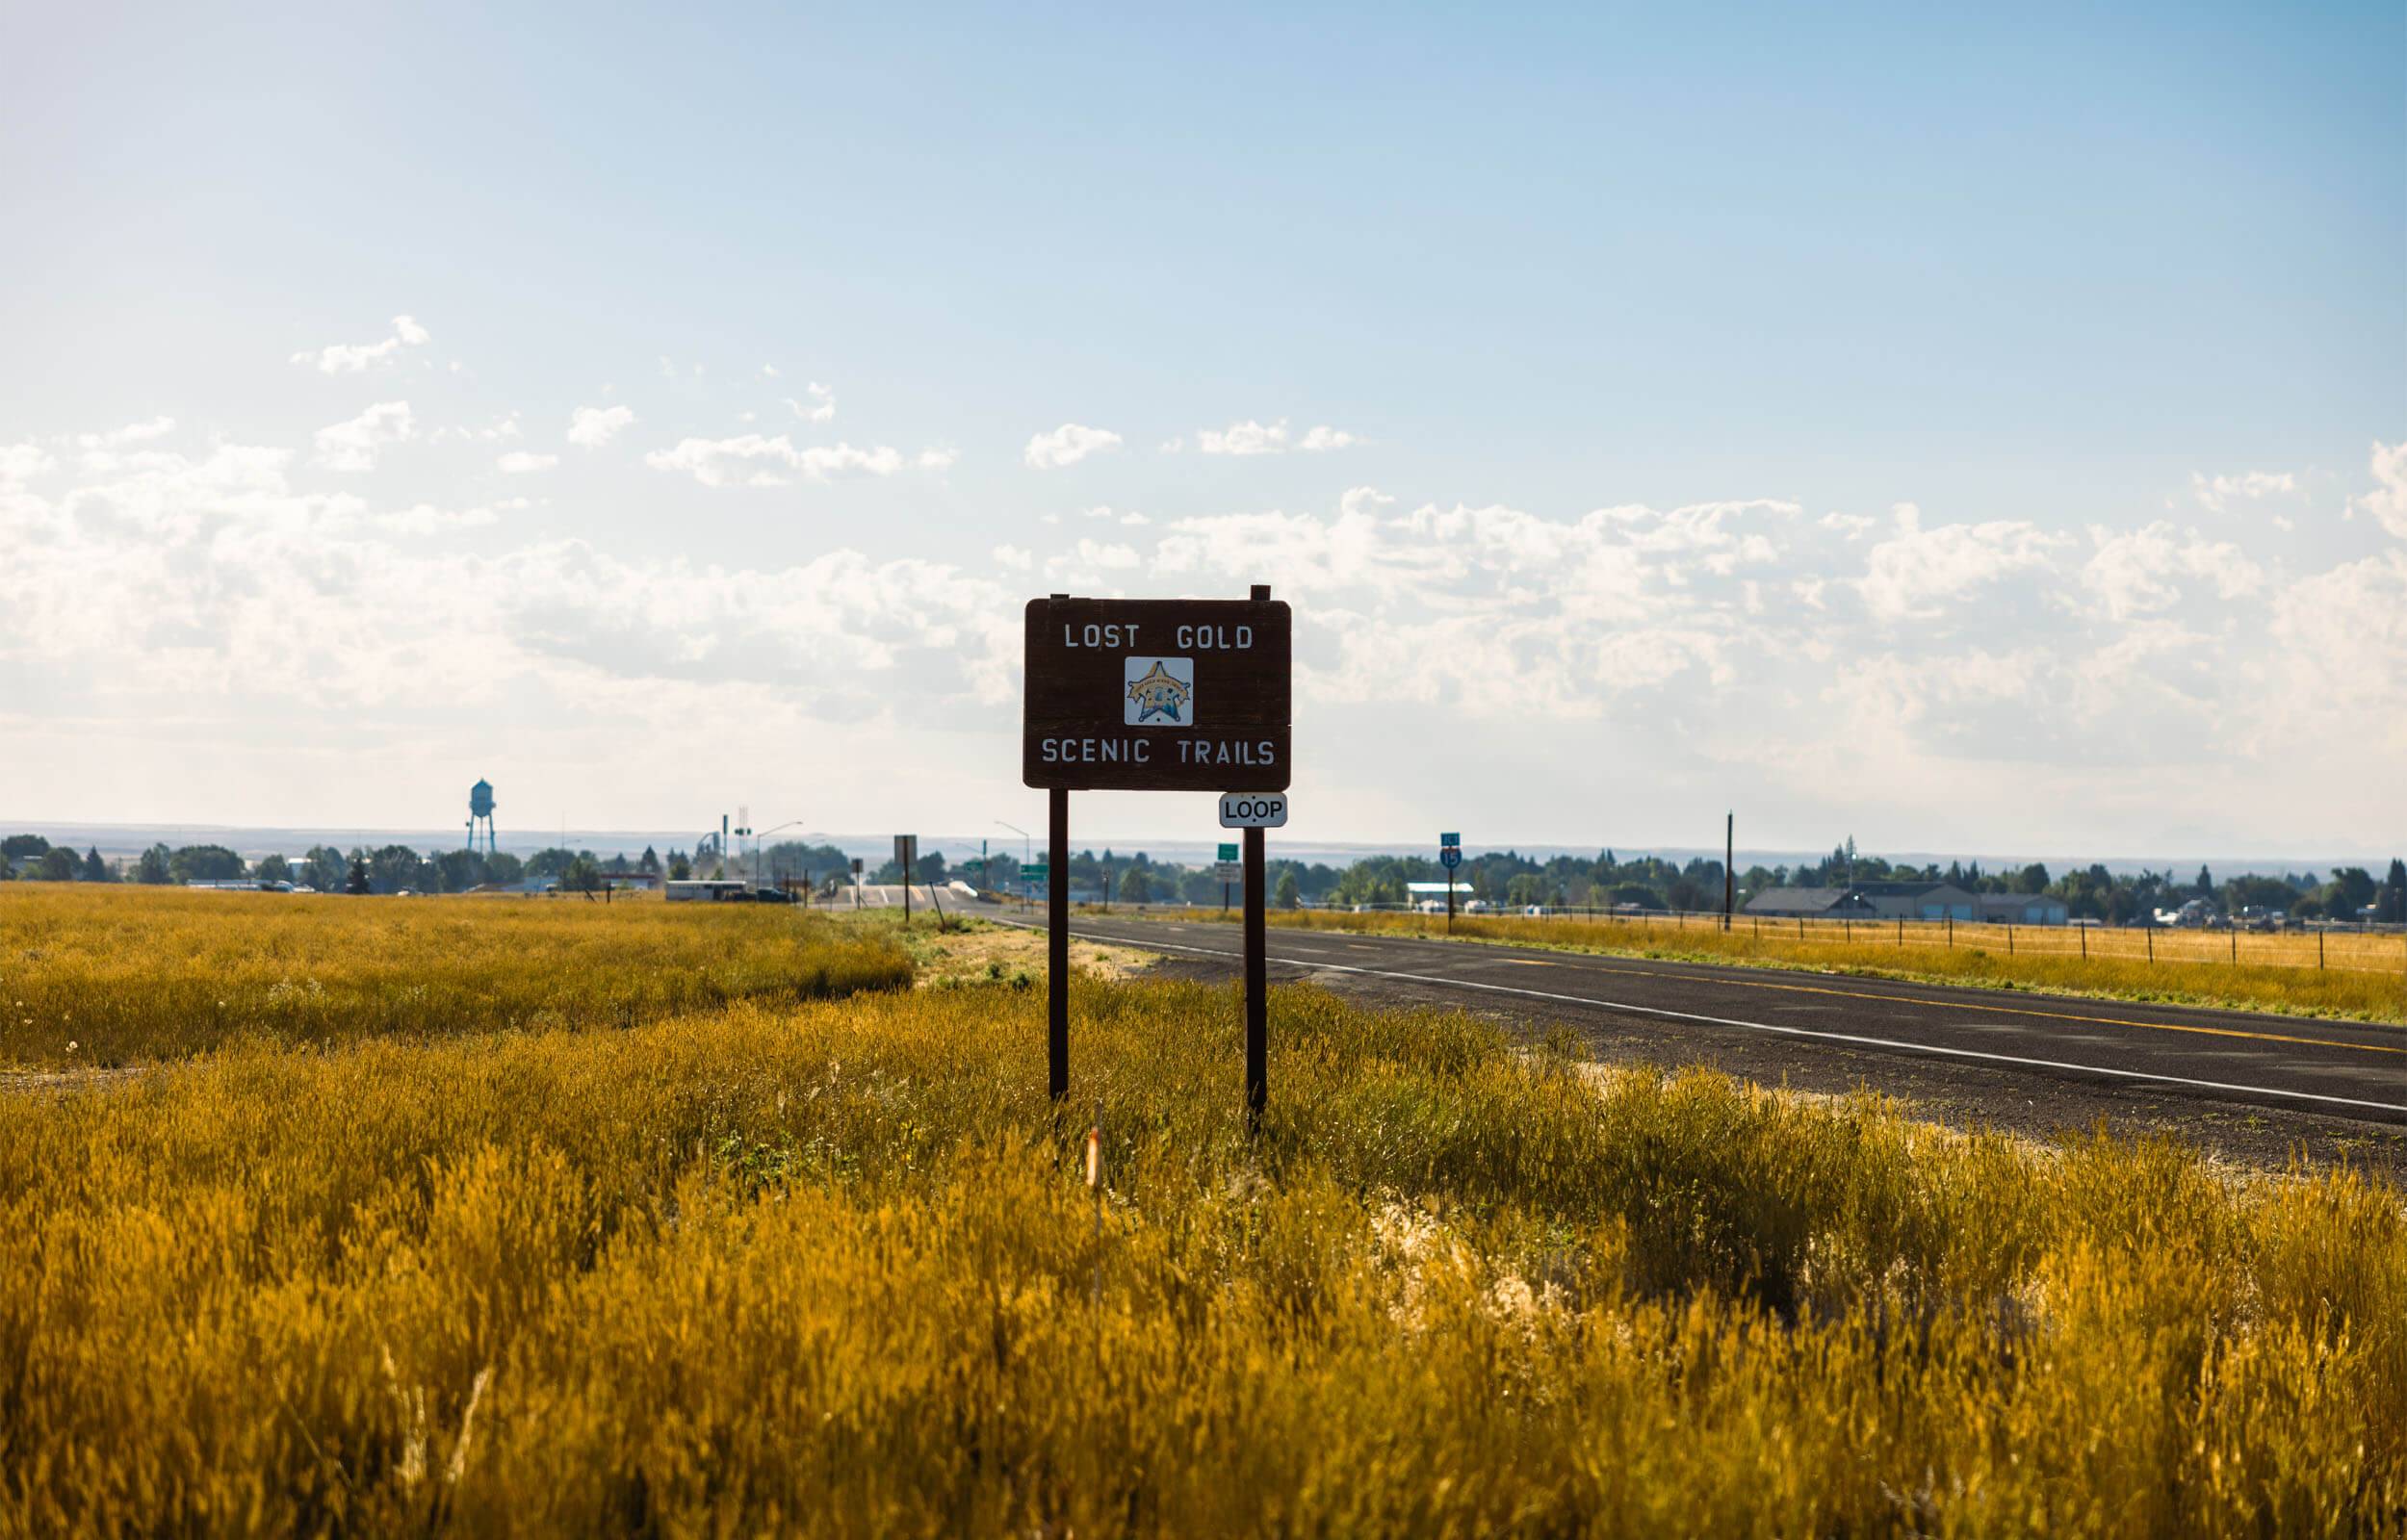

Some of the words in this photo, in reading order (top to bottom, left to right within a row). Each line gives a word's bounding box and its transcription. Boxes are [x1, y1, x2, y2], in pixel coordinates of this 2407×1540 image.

[1065, 624, 1140, 648] LOST
[1177, 625, 1253, 650] GOLD
[1042, 738, 1151, 763] SCENIC
[1177, 740, 1275, 765] TRAILS
[1225, 800, 1283, 819] LOOP
[1444, 853, 1458, 865] 15
